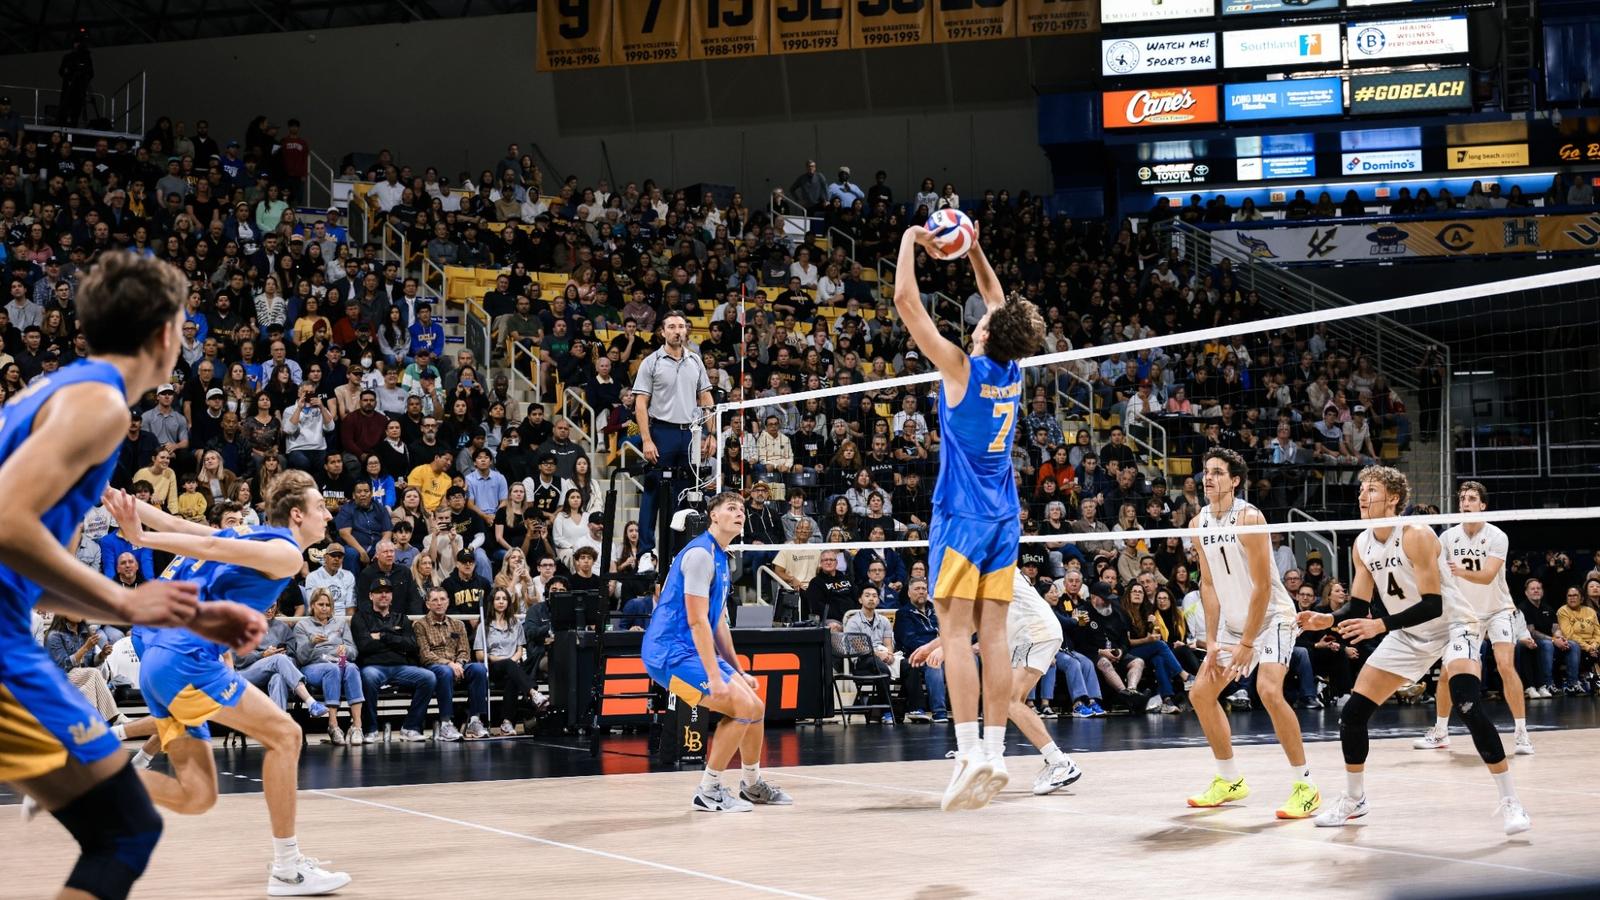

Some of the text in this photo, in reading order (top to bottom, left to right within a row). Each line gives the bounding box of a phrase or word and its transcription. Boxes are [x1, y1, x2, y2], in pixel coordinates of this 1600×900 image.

[1031, 19, 1088, 32] 1970-1973
[947, 26, 1003, 39] 1971-1974
[782, 37, 838, 50] 1990-1993
[864, 33, 920, 45] 1990-1993
[1146, 38, 1210, 51] WATCH ME!
[1388, 38, 1444, 47] PERFORMANCE
[704, 44, 755, 56] 1988-1991
[1240, 40, 1297, 52] Southland
[549, 55, 600, 67] 1994-1996
[625, 49, 678, 61] 1990-1993
[1146, 55, 1212, 67] SPORTS BAR
[1355, 80, 1465, 102] #GOBEACH
[1126, 88, 1196, 124] Cane's
[1559, 144, 1580, 159] Go
[1362, 159, 1416, 171] Domino's
[1157, 171, 1190, 180] TOYOTA
[987, 401, 1014, 452] 7
[1454, 548, 1486, 557] BEACH
[1220, 546, 1230, 574] 1
[1387, 572, 1406, 600] 4
